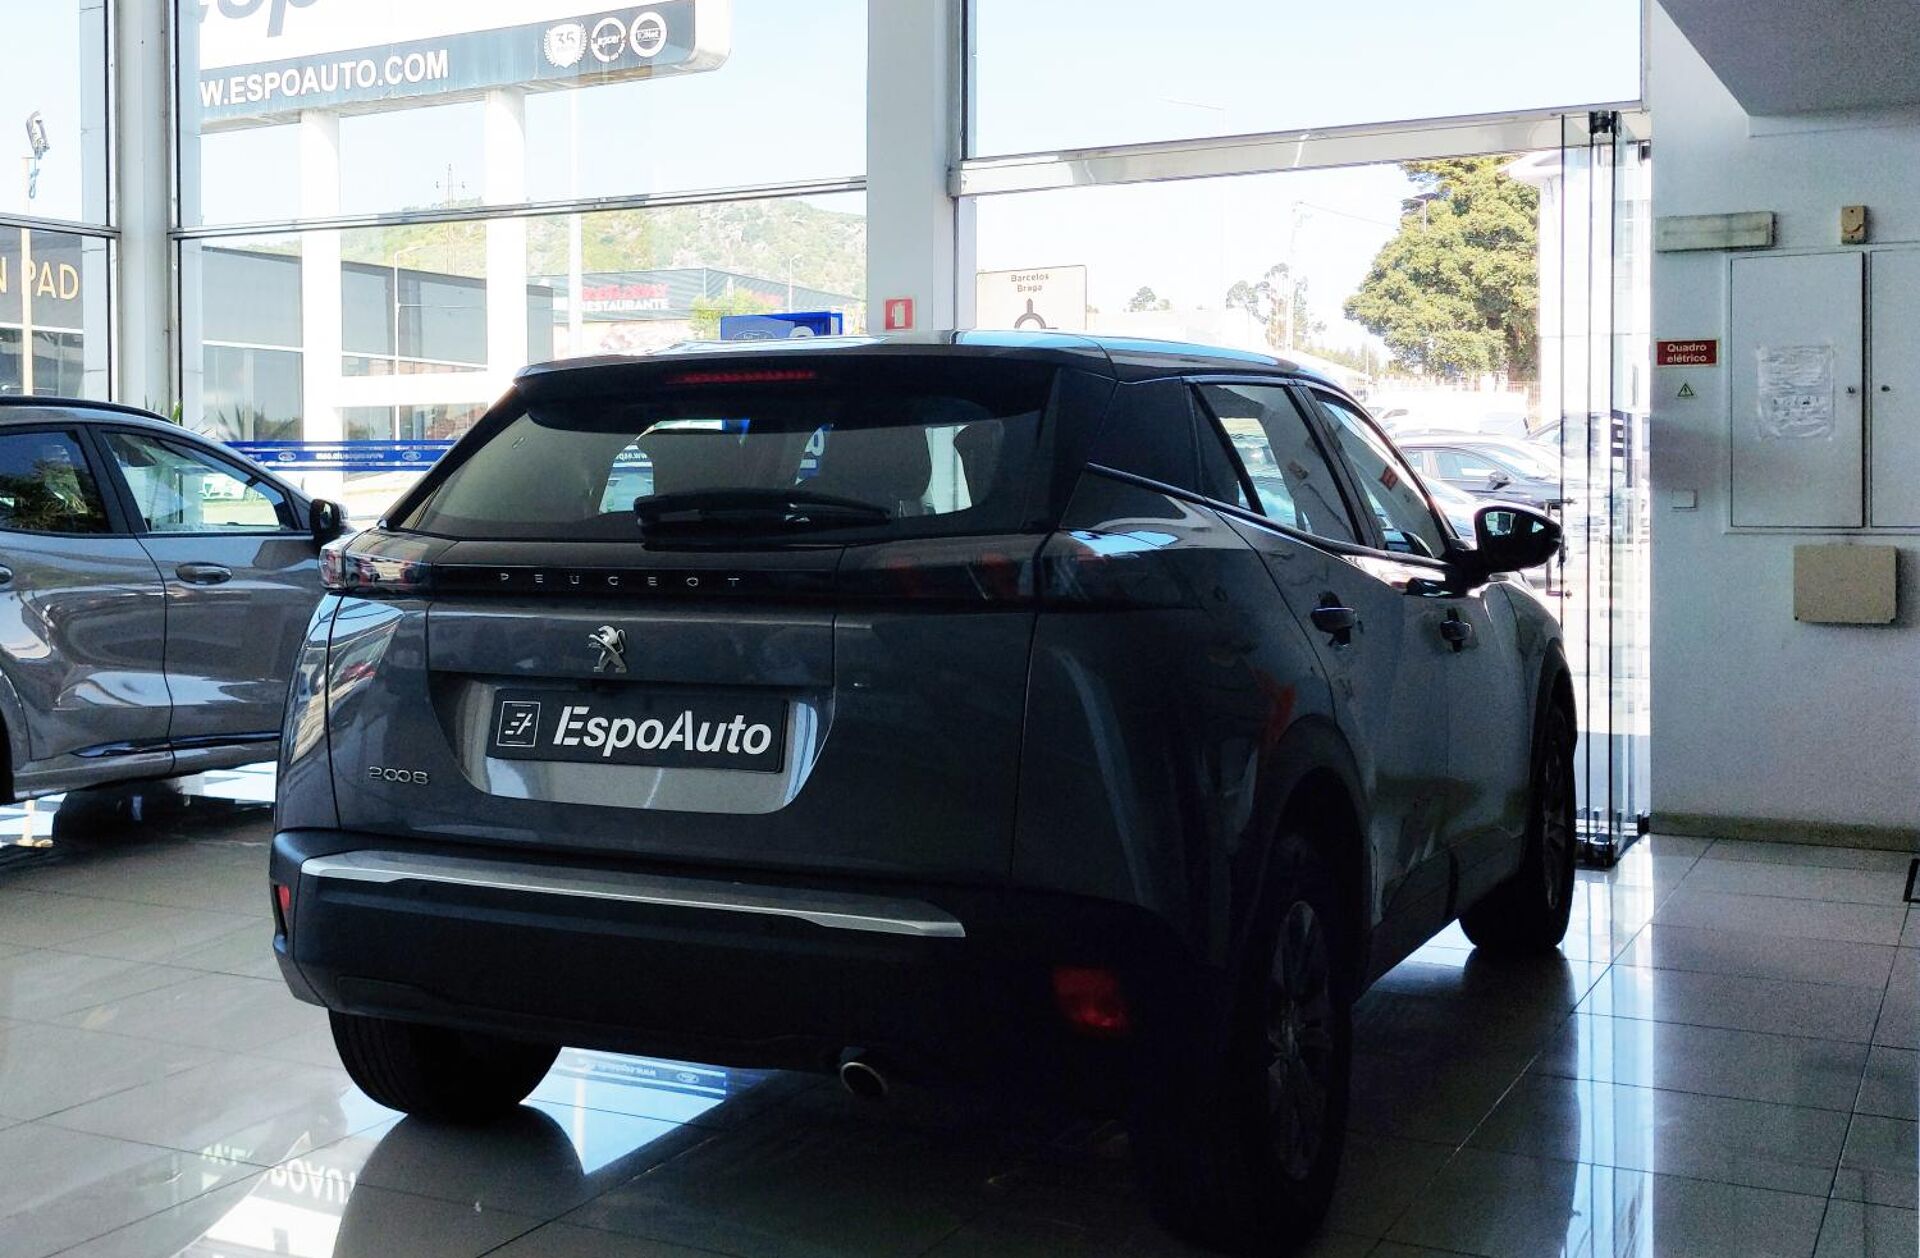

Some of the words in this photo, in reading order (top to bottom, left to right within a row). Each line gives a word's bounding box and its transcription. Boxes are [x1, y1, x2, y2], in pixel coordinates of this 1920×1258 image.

[1011, 273, 1049, 282] Barcelos
[1017, 284, 1043, 293] Braga
[1667, 343, 1707, 353] Quadro
[1667, 354, 1707, 363] elétrico
[500, 573, 740, 587] PEUGEOT
[553, 706, 772, 757] EspoAuto
[369, 766, 429, 784] 2008
